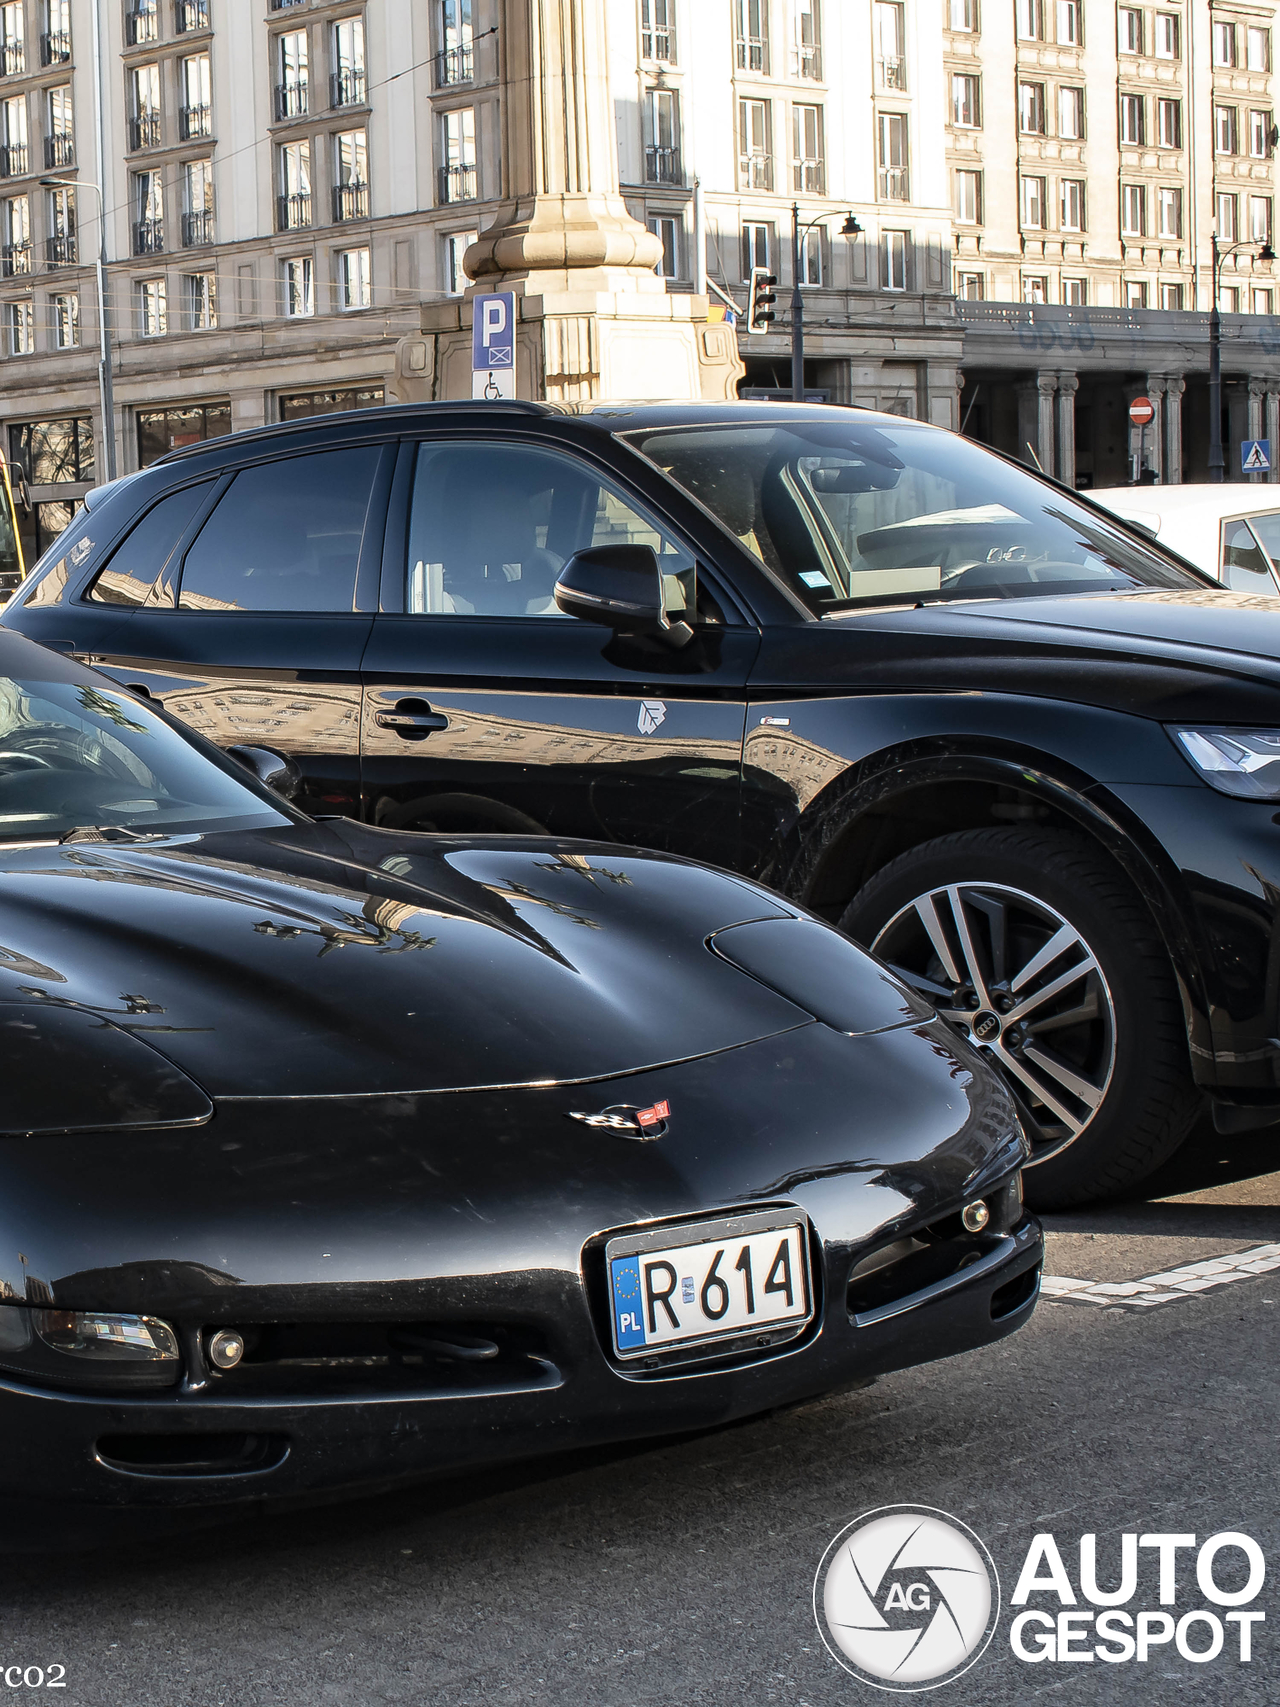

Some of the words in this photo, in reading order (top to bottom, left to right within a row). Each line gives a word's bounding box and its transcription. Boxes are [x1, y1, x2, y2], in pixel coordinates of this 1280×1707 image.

[482, 299, 507, 348] P
[644, 1260, 681, 1334] R
[700, 1238, 795, 1321] 614
[620, 1311, 641, 1334] PL
